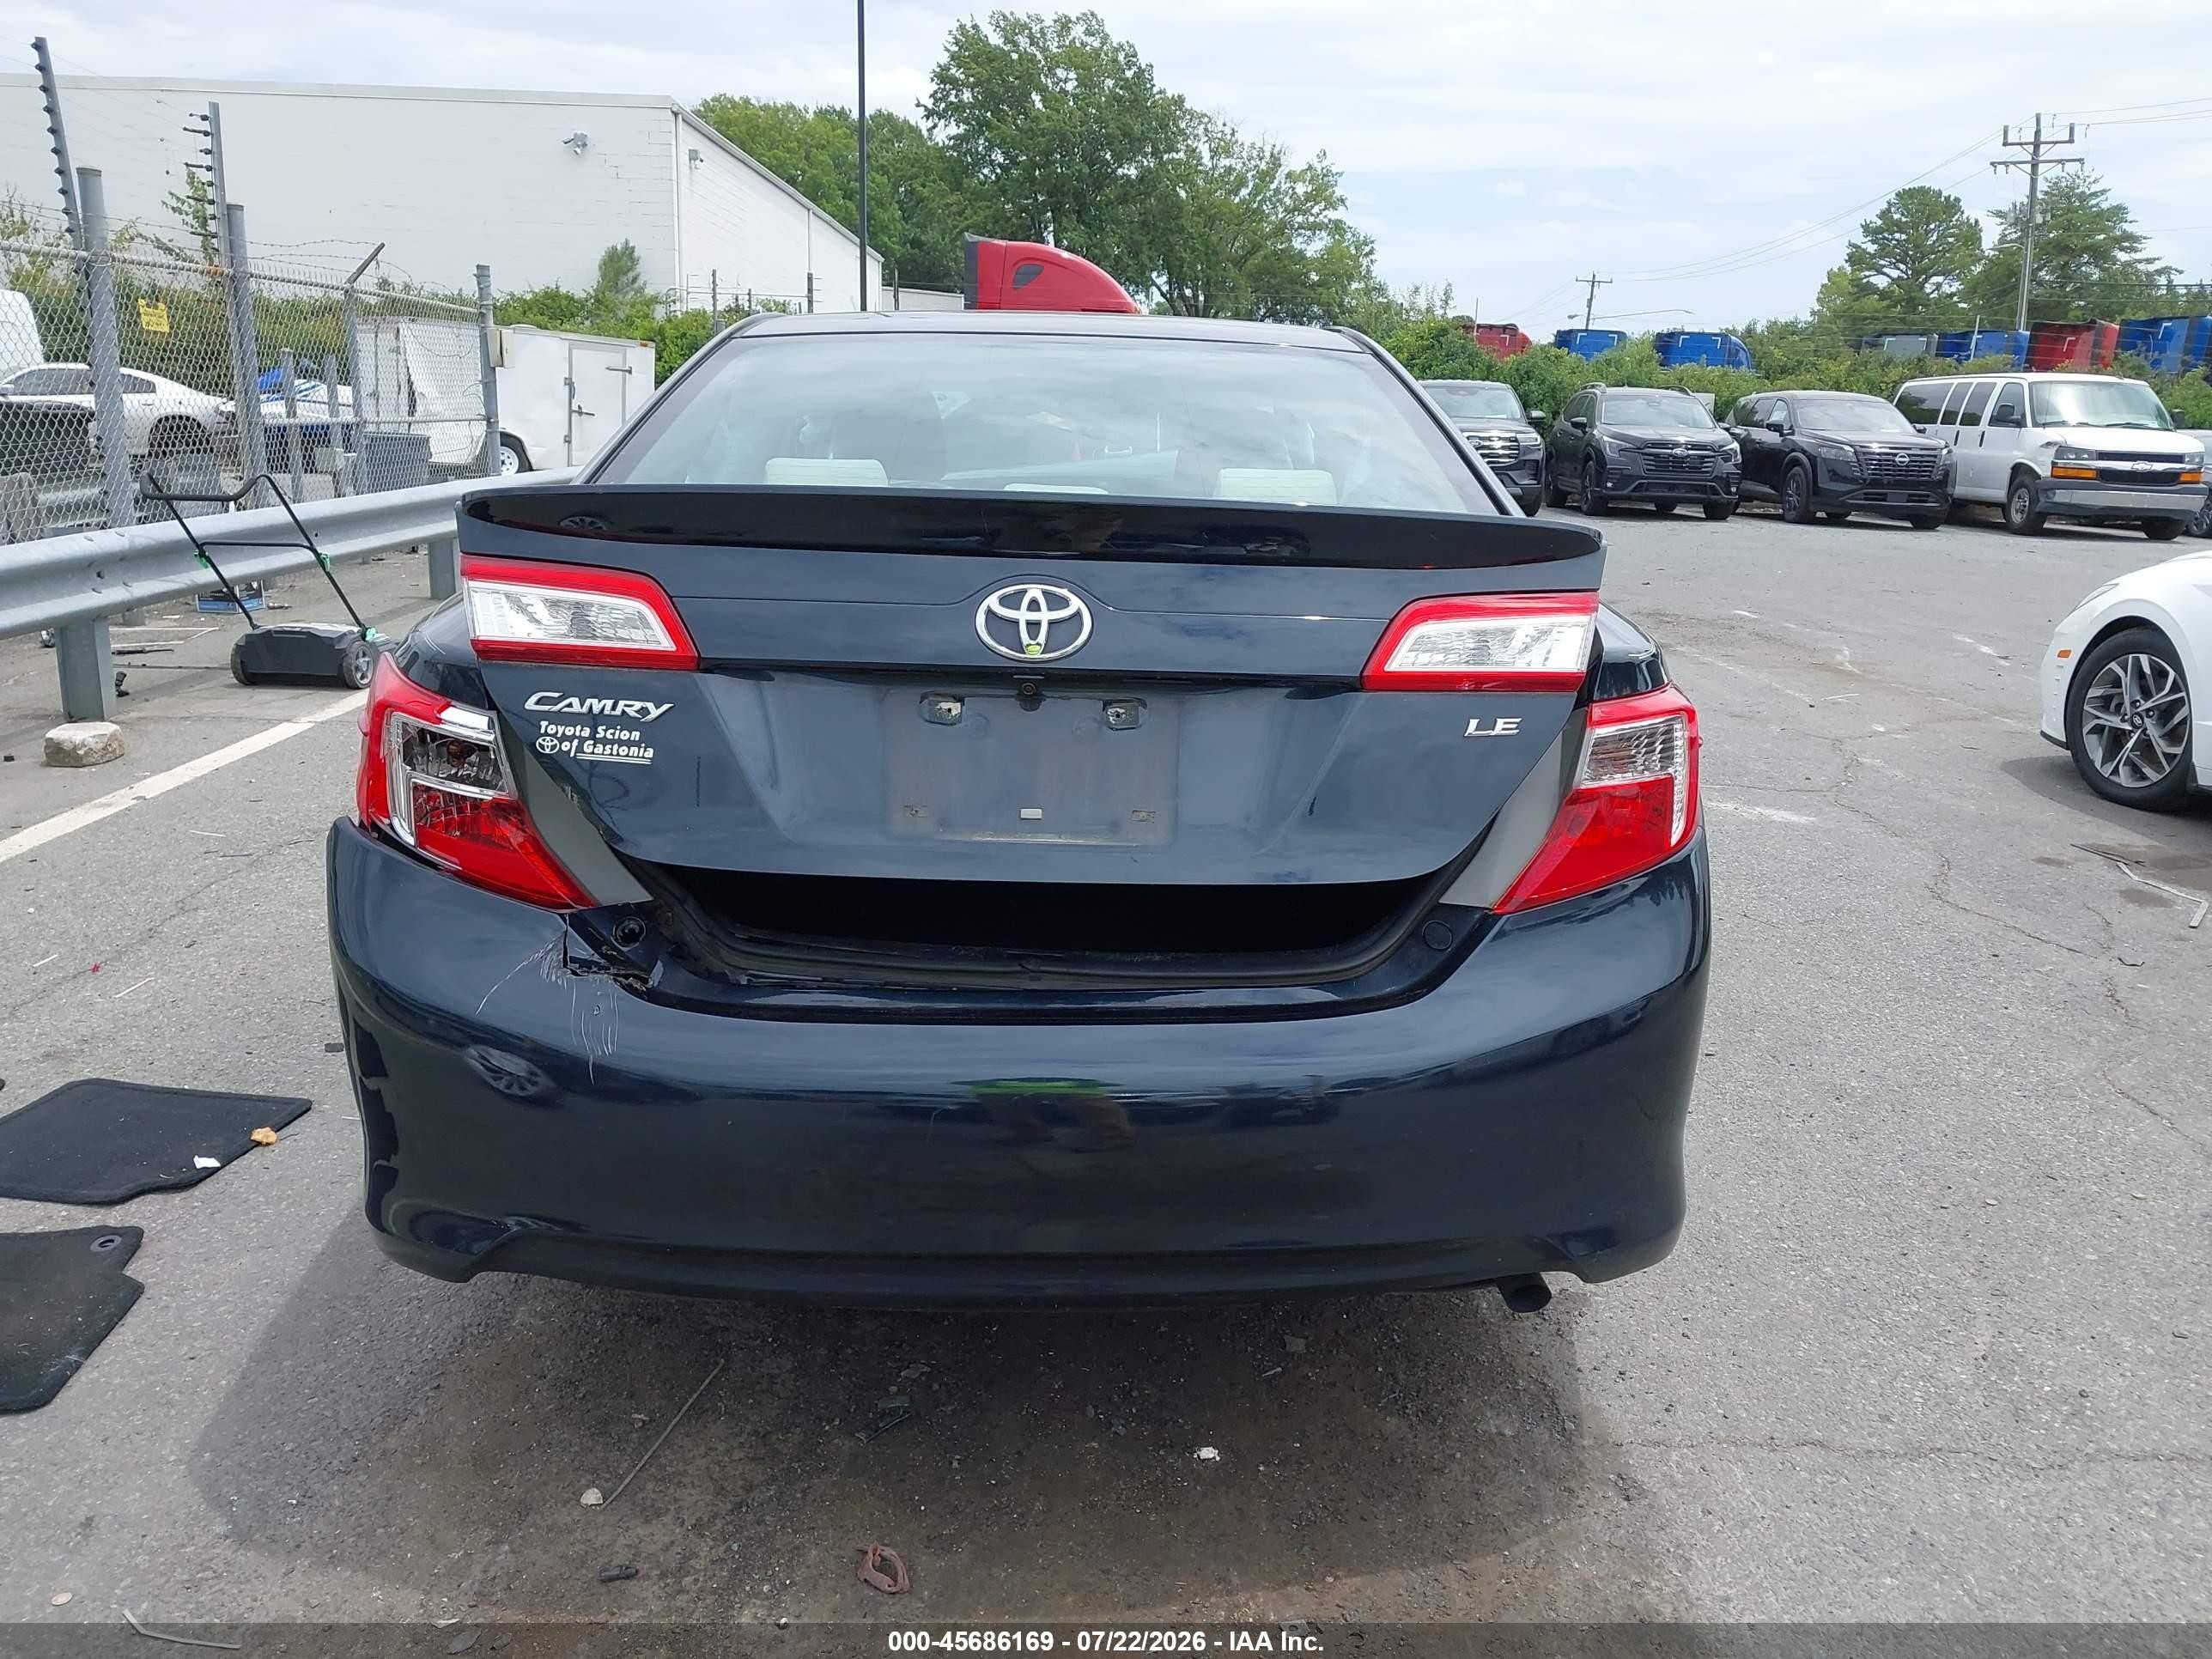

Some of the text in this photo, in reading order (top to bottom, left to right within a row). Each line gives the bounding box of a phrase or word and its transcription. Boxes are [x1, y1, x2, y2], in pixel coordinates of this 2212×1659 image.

[524, 691, 675, 722] CAMRY
[539, 720, 641, 741] Toyota Scion
[1463, 718, 1522, 737] LE
[561, 738, 654, 758] of Gastonia
